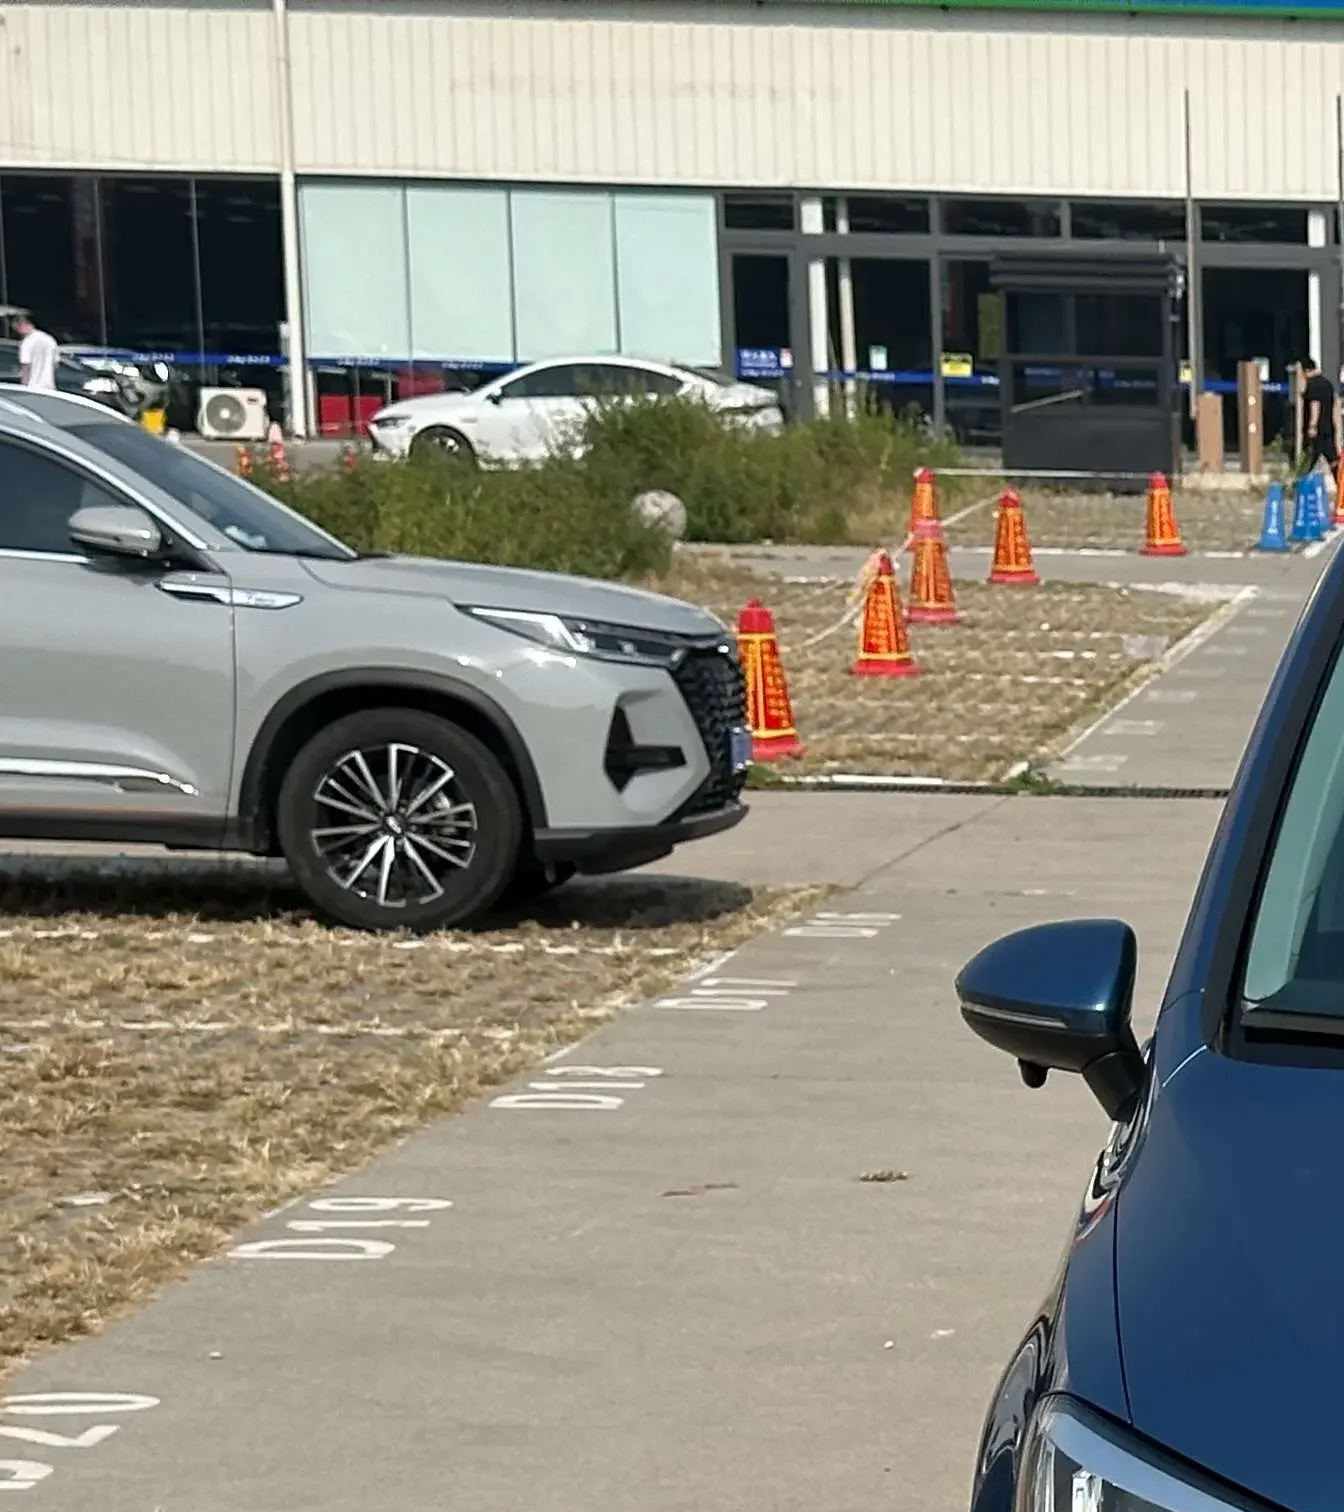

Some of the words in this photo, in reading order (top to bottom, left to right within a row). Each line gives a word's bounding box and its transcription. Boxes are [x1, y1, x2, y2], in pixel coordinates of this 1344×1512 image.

[653, 978, 799, 1011] D17
[488, 1065, 664, 1110] D18
[226, 1196, 454, 1260] D19
